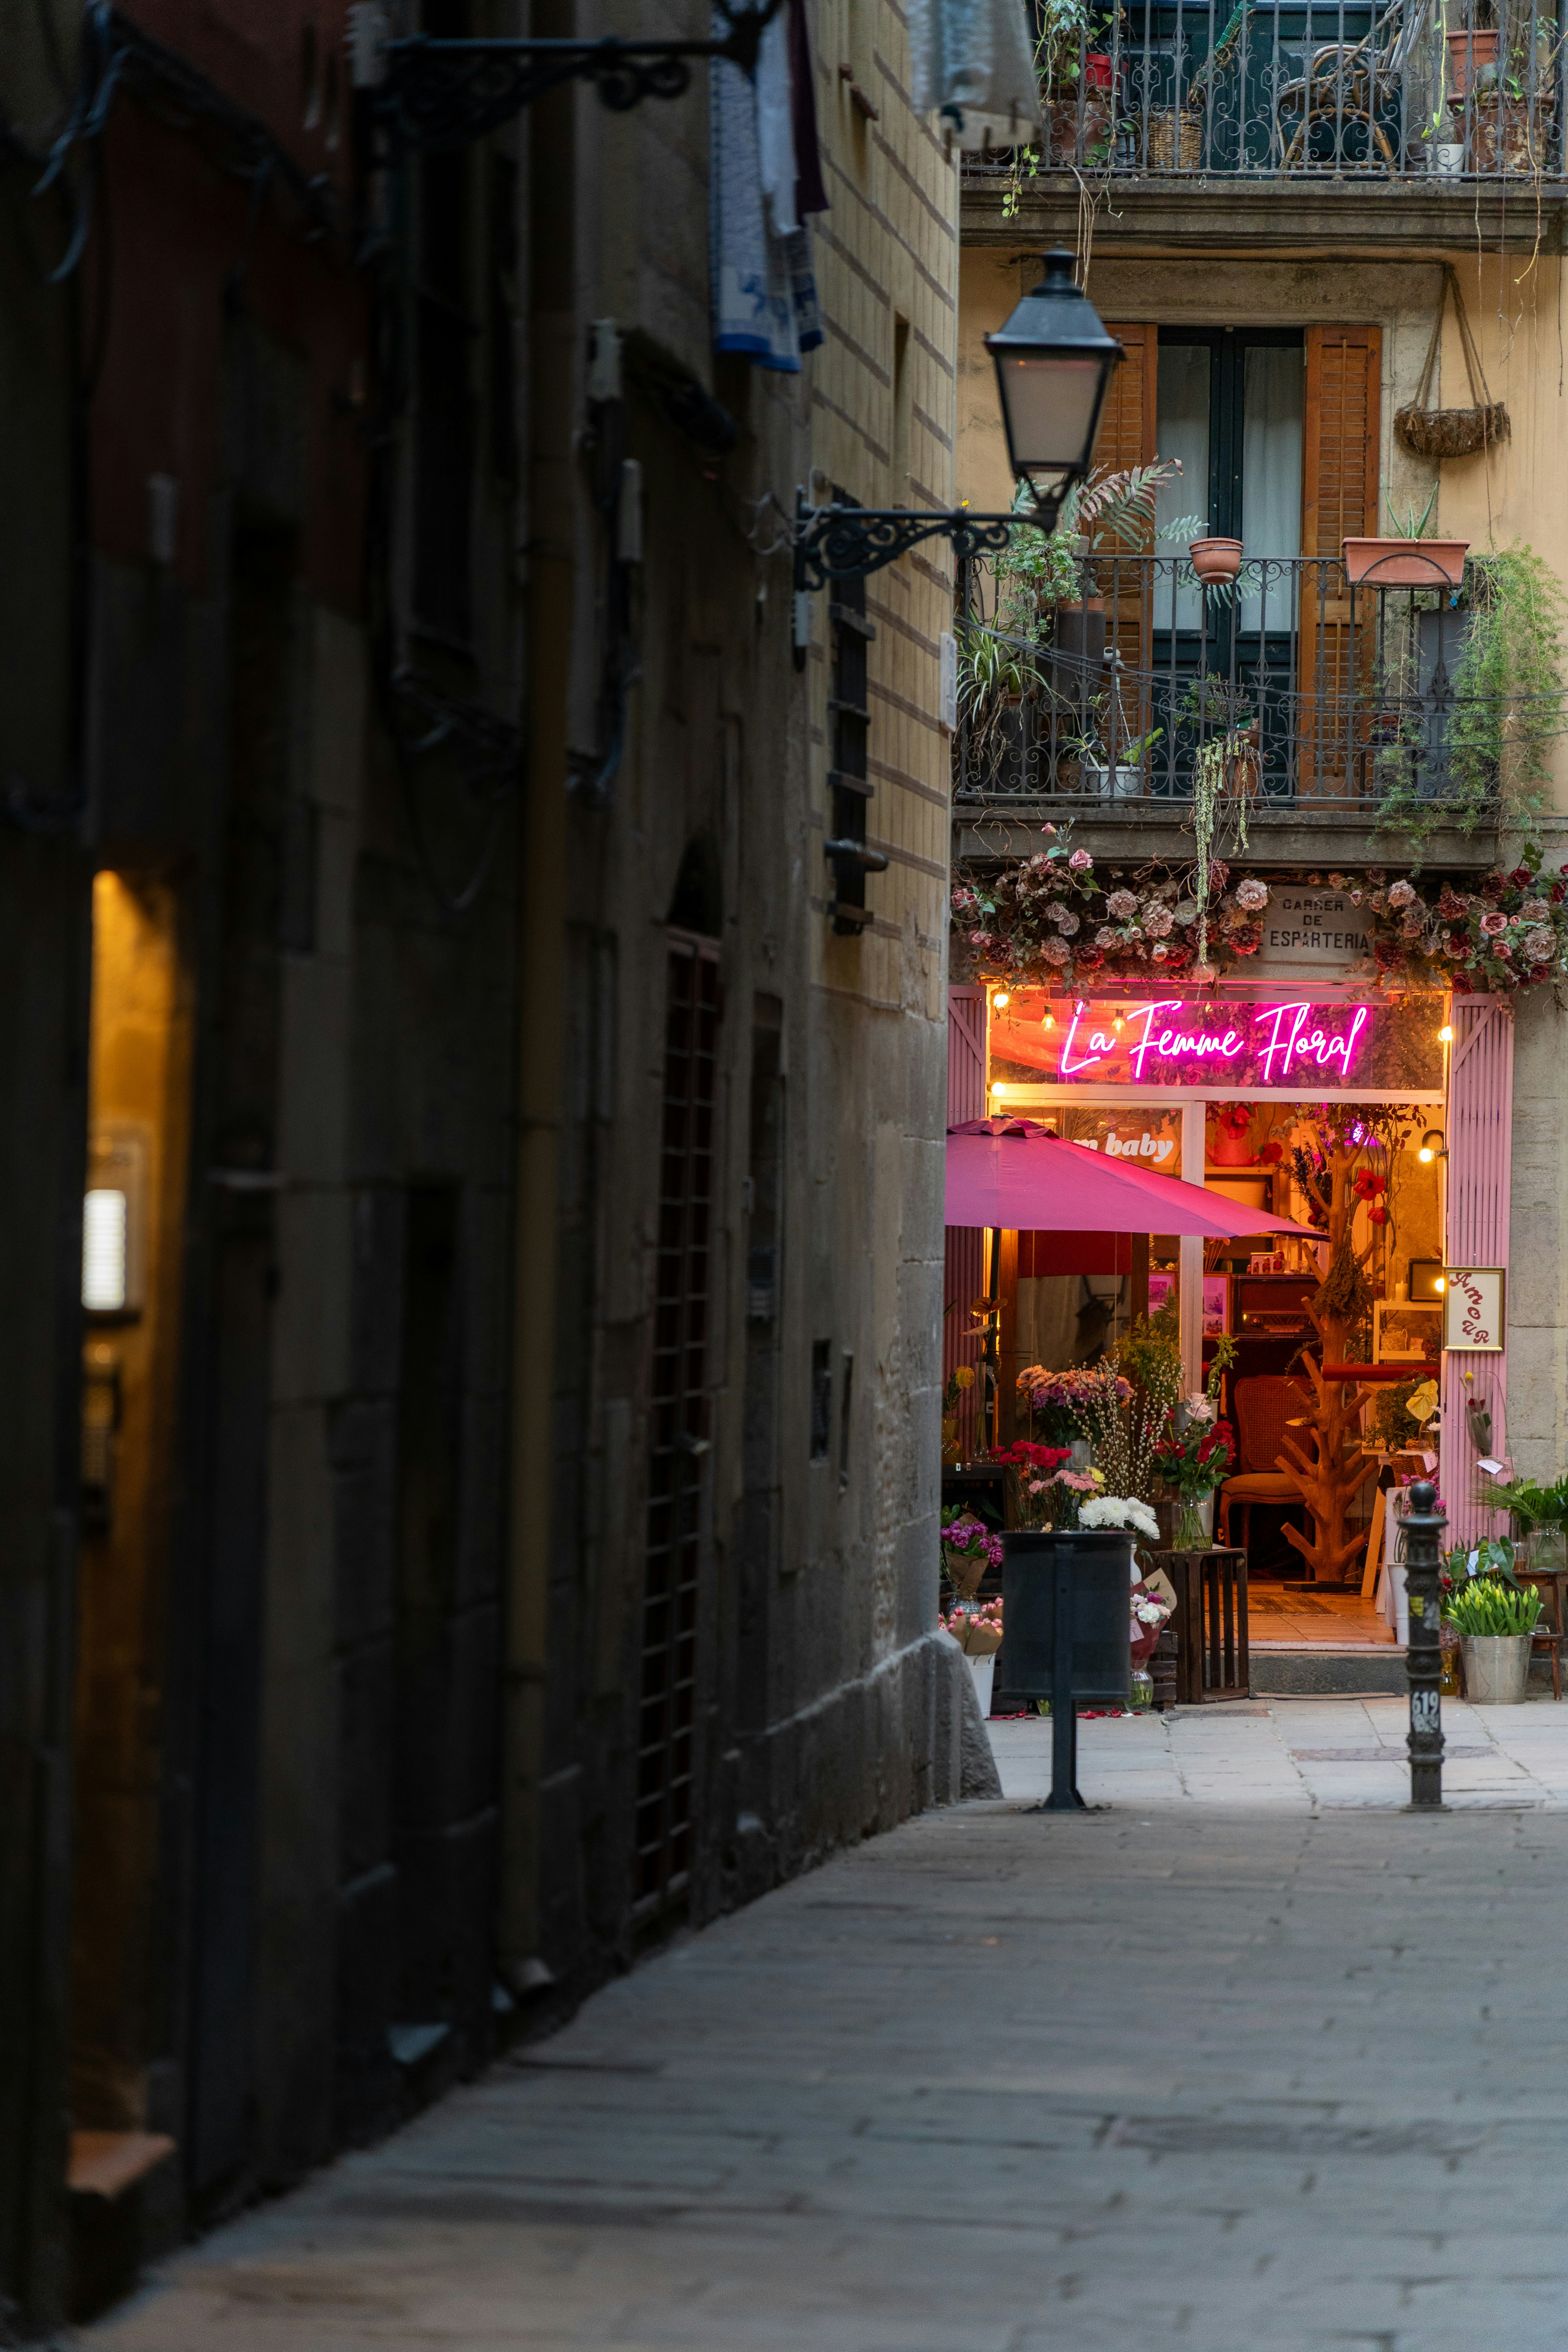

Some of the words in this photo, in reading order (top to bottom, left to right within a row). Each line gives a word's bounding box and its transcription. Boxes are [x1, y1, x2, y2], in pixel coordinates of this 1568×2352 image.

[1283, 899, 1343, 911] CARRER
[1303, 915, 1322, 926] DE
[1257, 930, 1368, 949] 'ESPARTERIA
[1060, 1001, 1116, 1073] La
[1126, 1000, 1244, 1078] Femme
[1255, 1002, 1367, 1080] Floral
[1105, 1133, 1173, 1162] baby
[1412, 1691, 1439, 1715] 619
